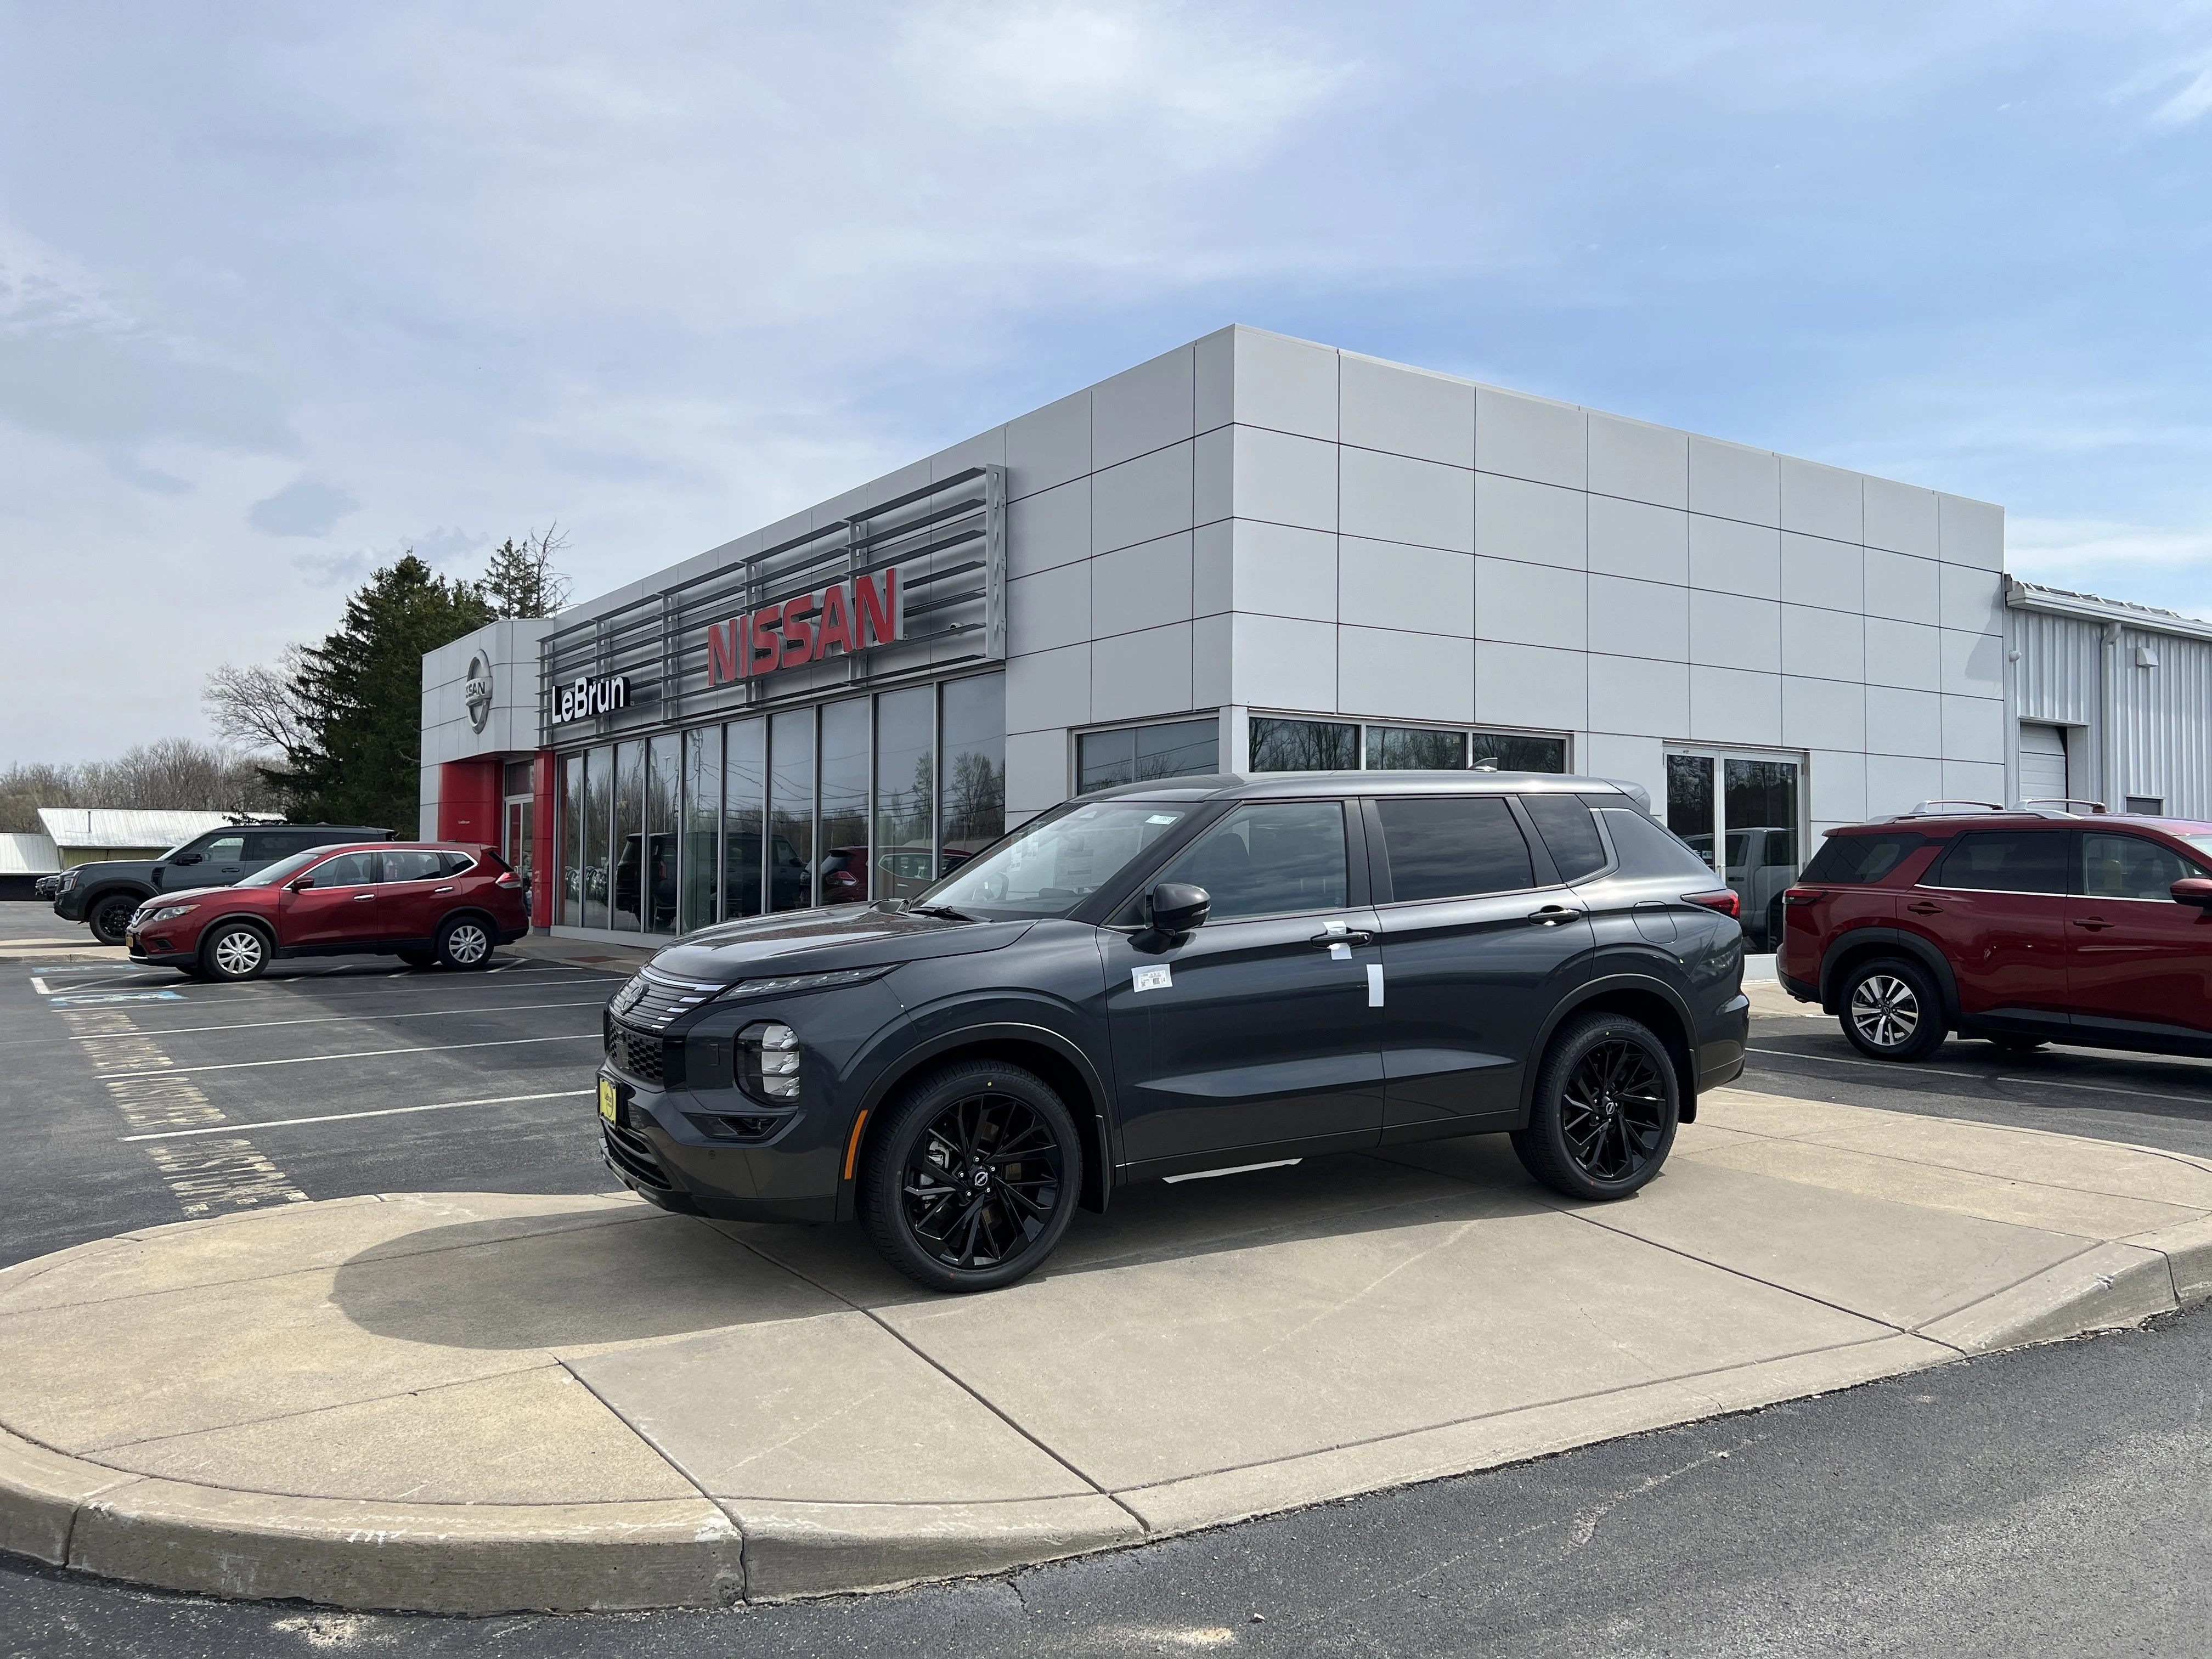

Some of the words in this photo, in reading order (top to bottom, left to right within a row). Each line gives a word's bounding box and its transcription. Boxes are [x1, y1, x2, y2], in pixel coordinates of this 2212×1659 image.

[708, 568, 895, 686] NISSAN
[552, 676, 624, 724] LeBrun
[145, 1138, 309, 1219] CUSTOME
